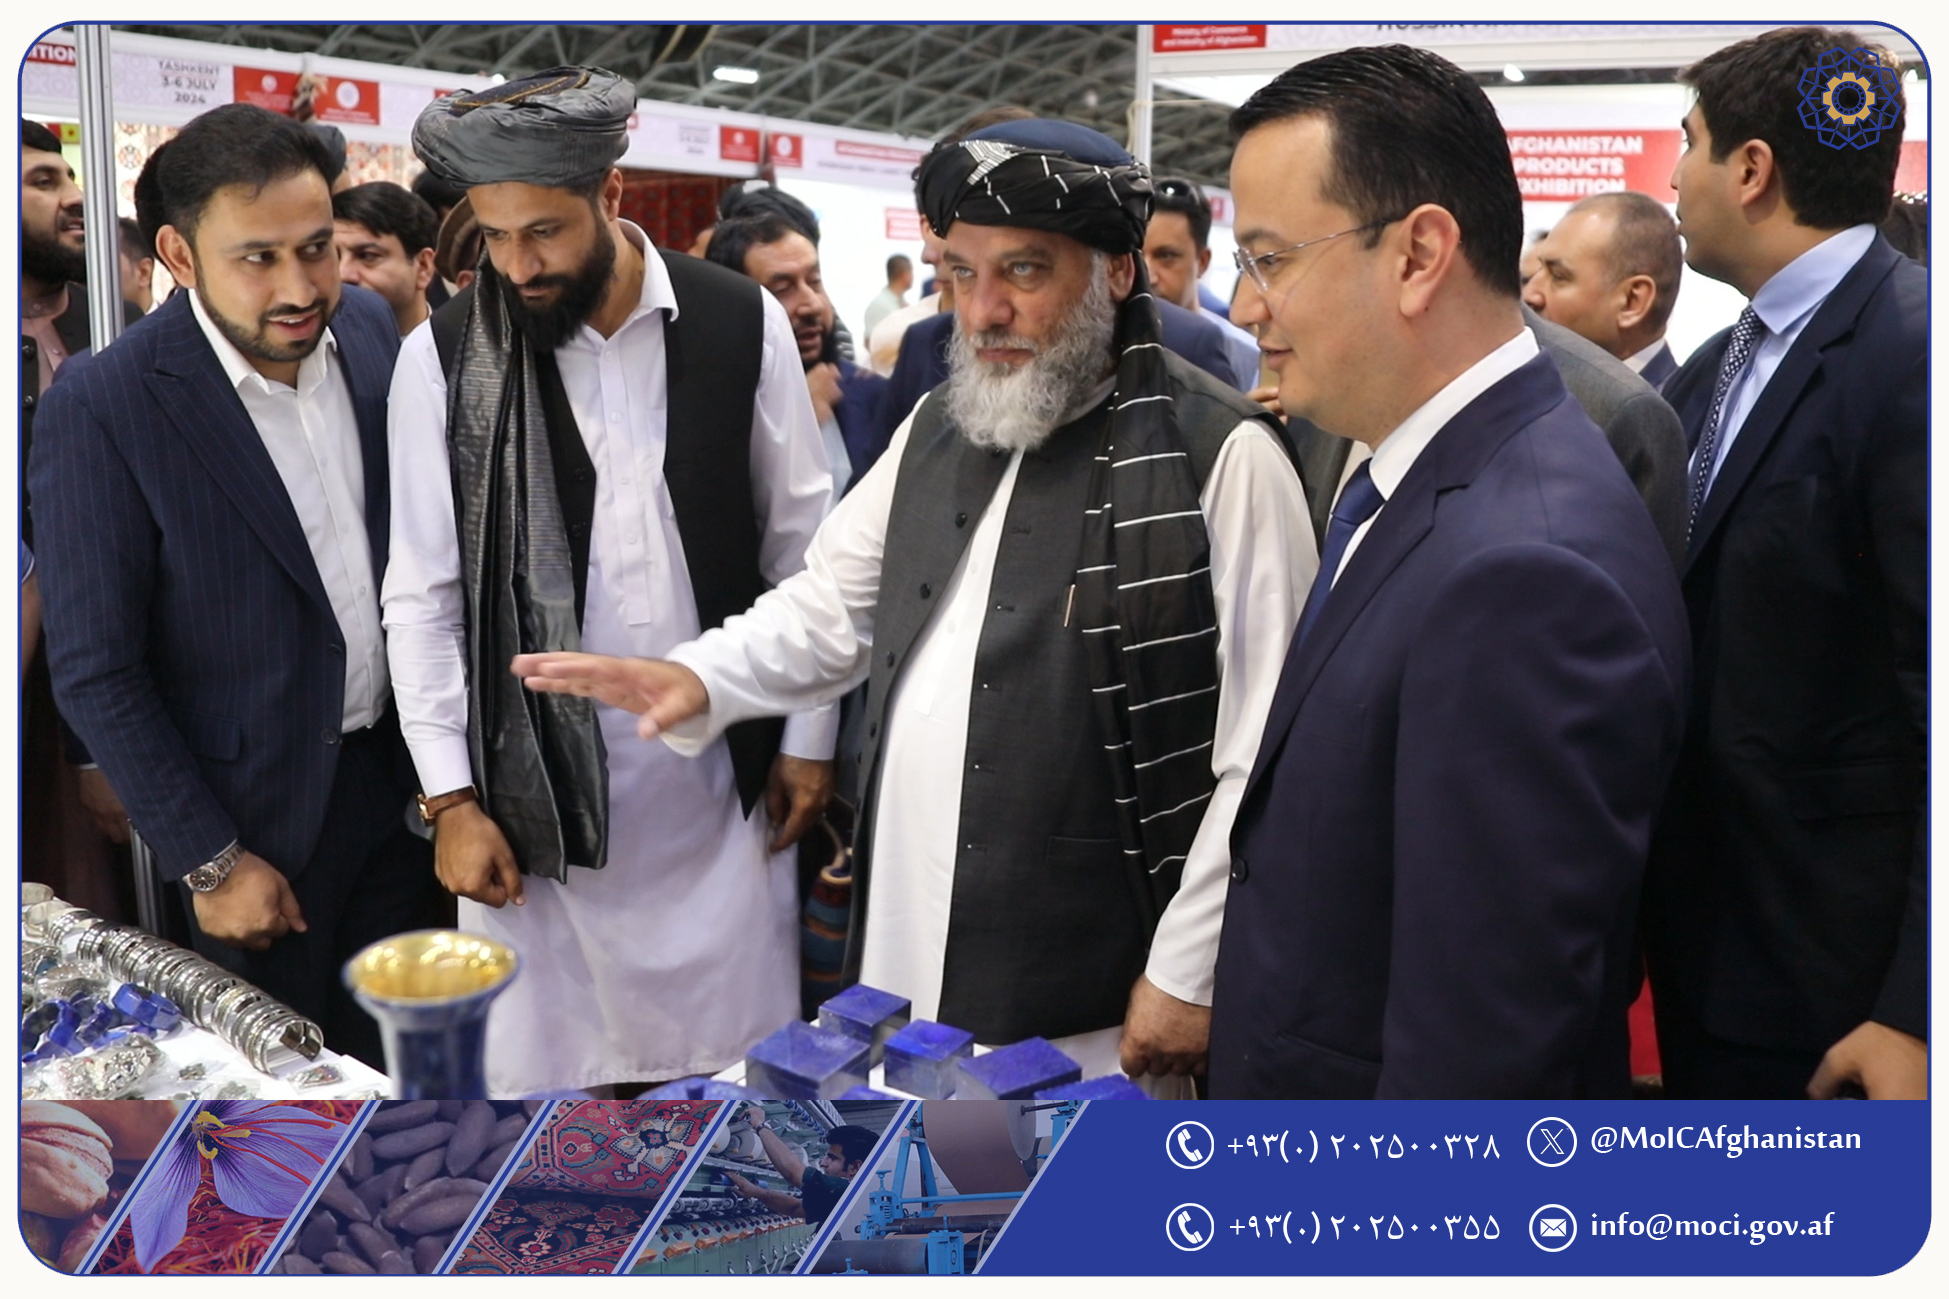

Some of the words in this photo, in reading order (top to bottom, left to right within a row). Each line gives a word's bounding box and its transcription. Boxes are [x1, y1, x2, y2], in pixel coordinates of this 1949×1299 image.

[159, 60, 219, 75] TASHKENT
[162, 76, 182, 88] 3-6
[187, 77, 217, 90] JULY
[175, 92, 206, 104] 2024
[1513, 156, 1625, 176] PRODUCTS
